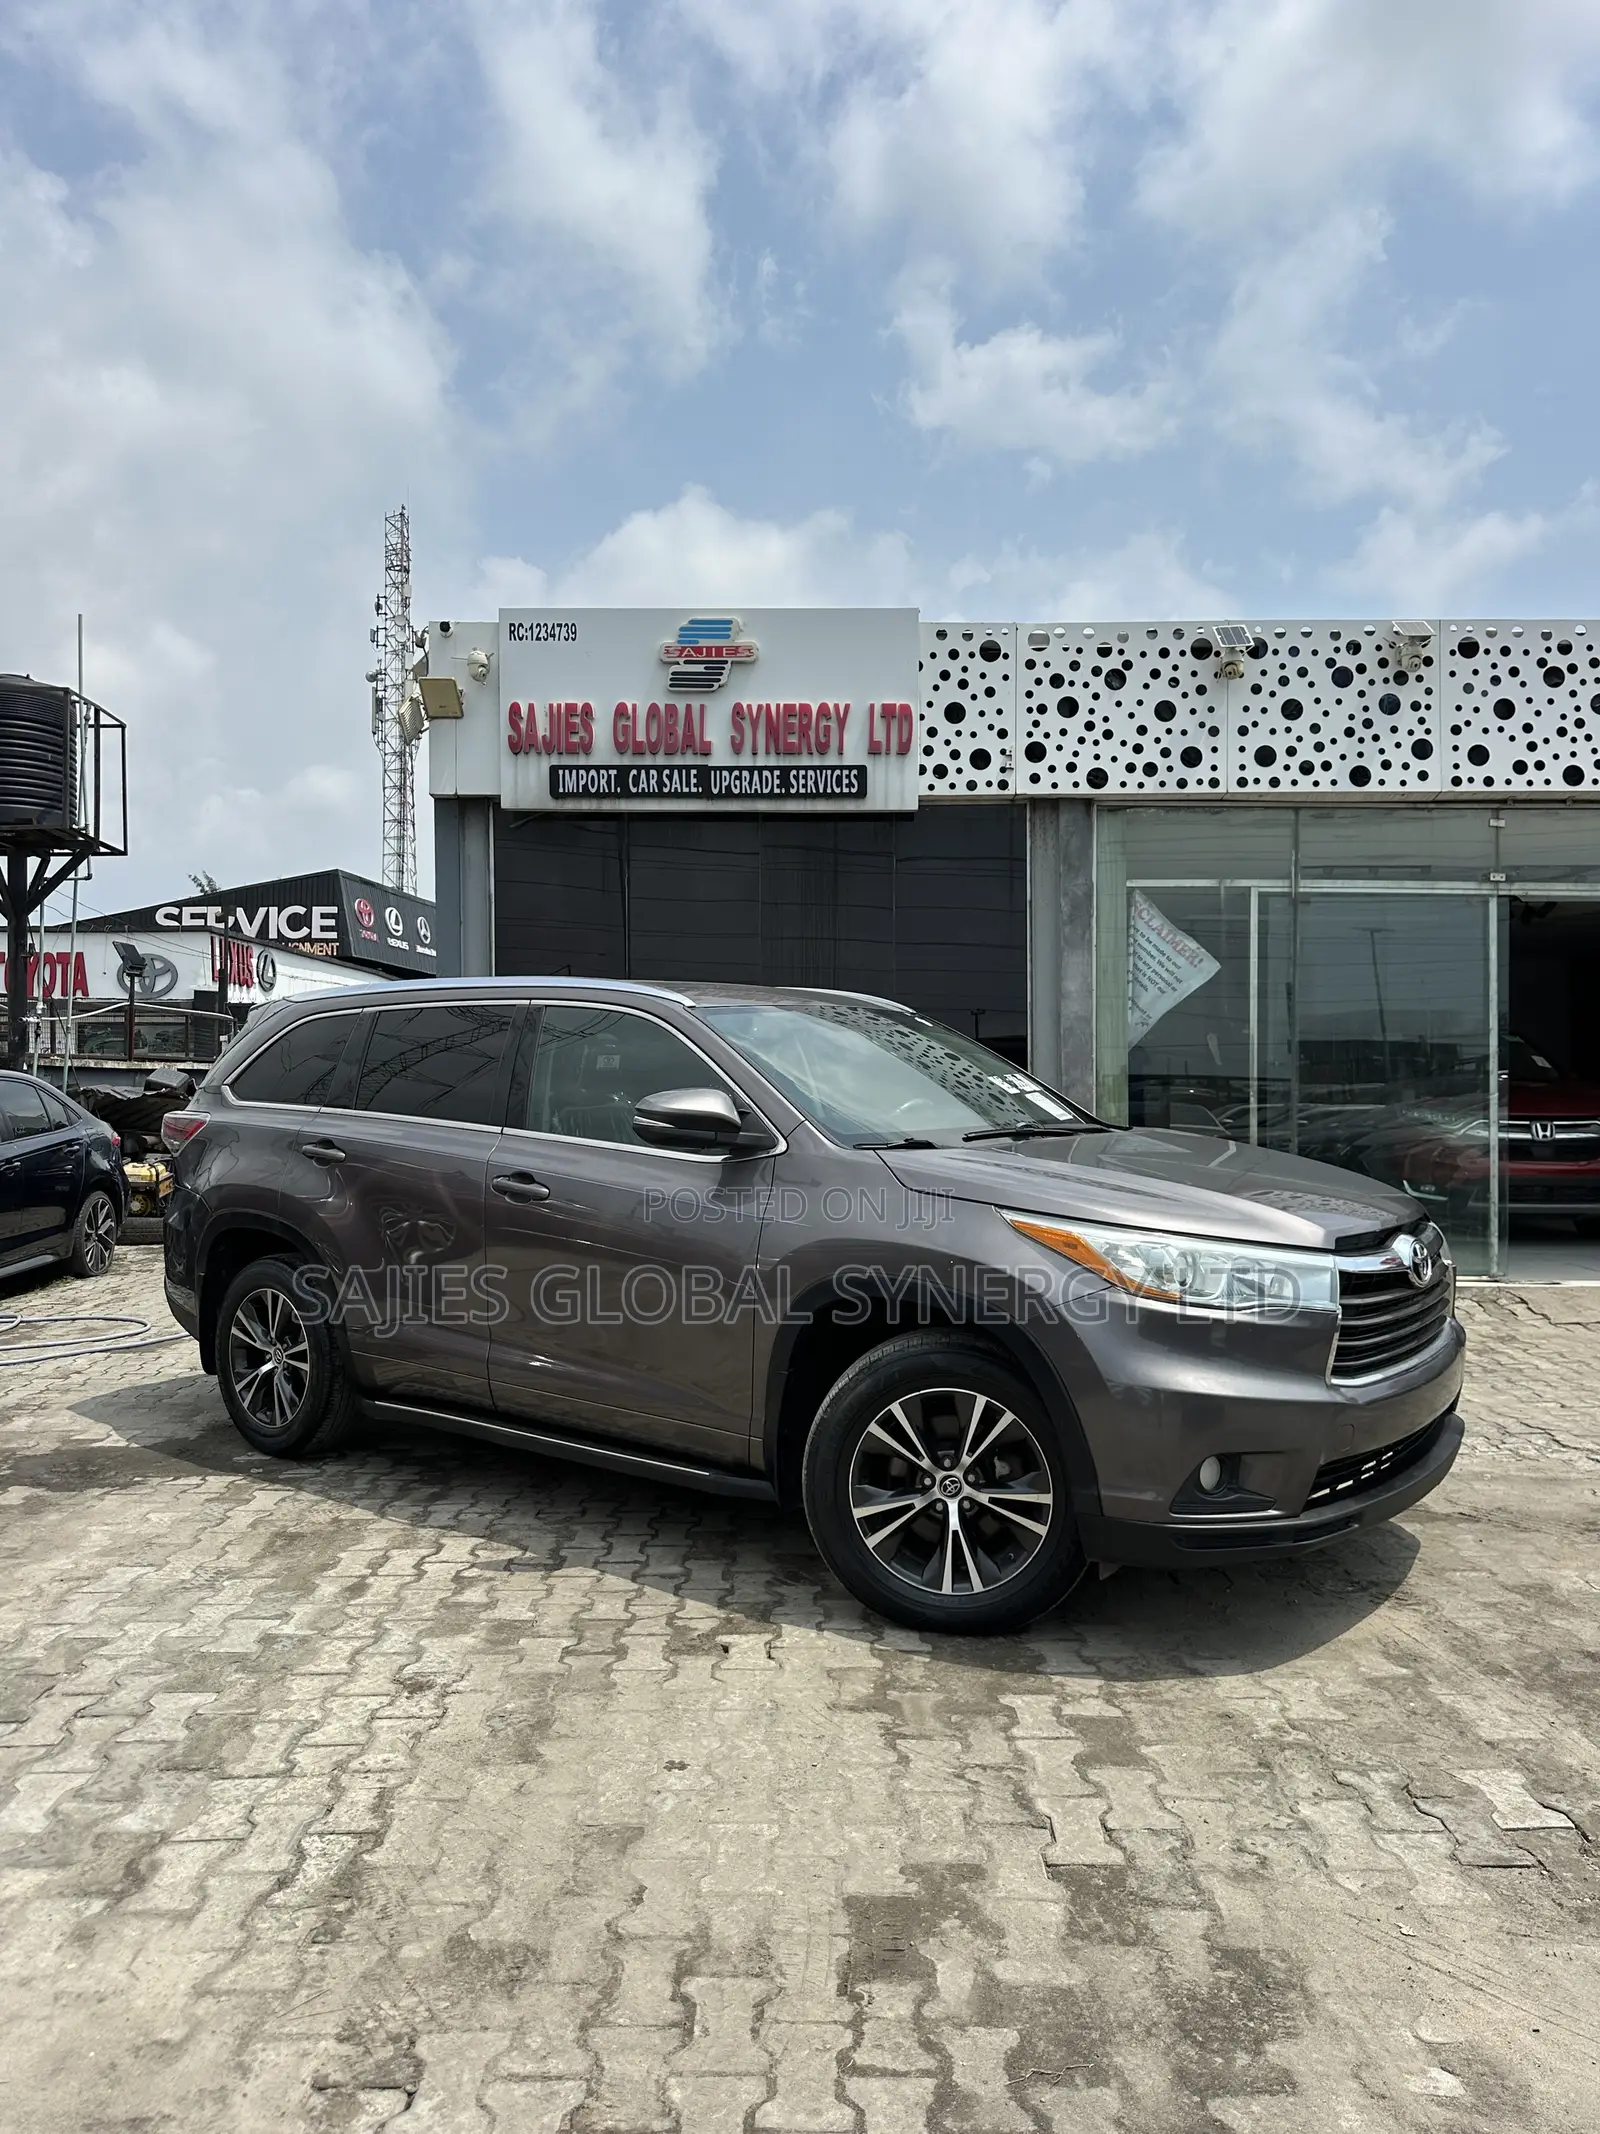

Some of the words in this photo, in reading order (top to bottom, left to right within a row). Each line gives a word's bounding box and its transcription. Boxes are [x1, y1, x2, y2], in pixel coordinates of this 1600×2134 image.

[509, 622, 577, 642] RC:1234739
[664, 646, 754, 658] SAJIES
[507, 701, 596, 755] SAJIES
[612, 702, 713, 756] GLOBAL
[730, 702, 851, 756] SYNERGY
[867, 703, 914, 756] LTD
[558, 769, 621, 793] IMPORT.
[629, 769, 659, 793] CAR
[662, 769, 703, 793] SALE.
[710, 770, 785, 794] UPGRADE.
[789, 769, 858, 793] SERVICES
